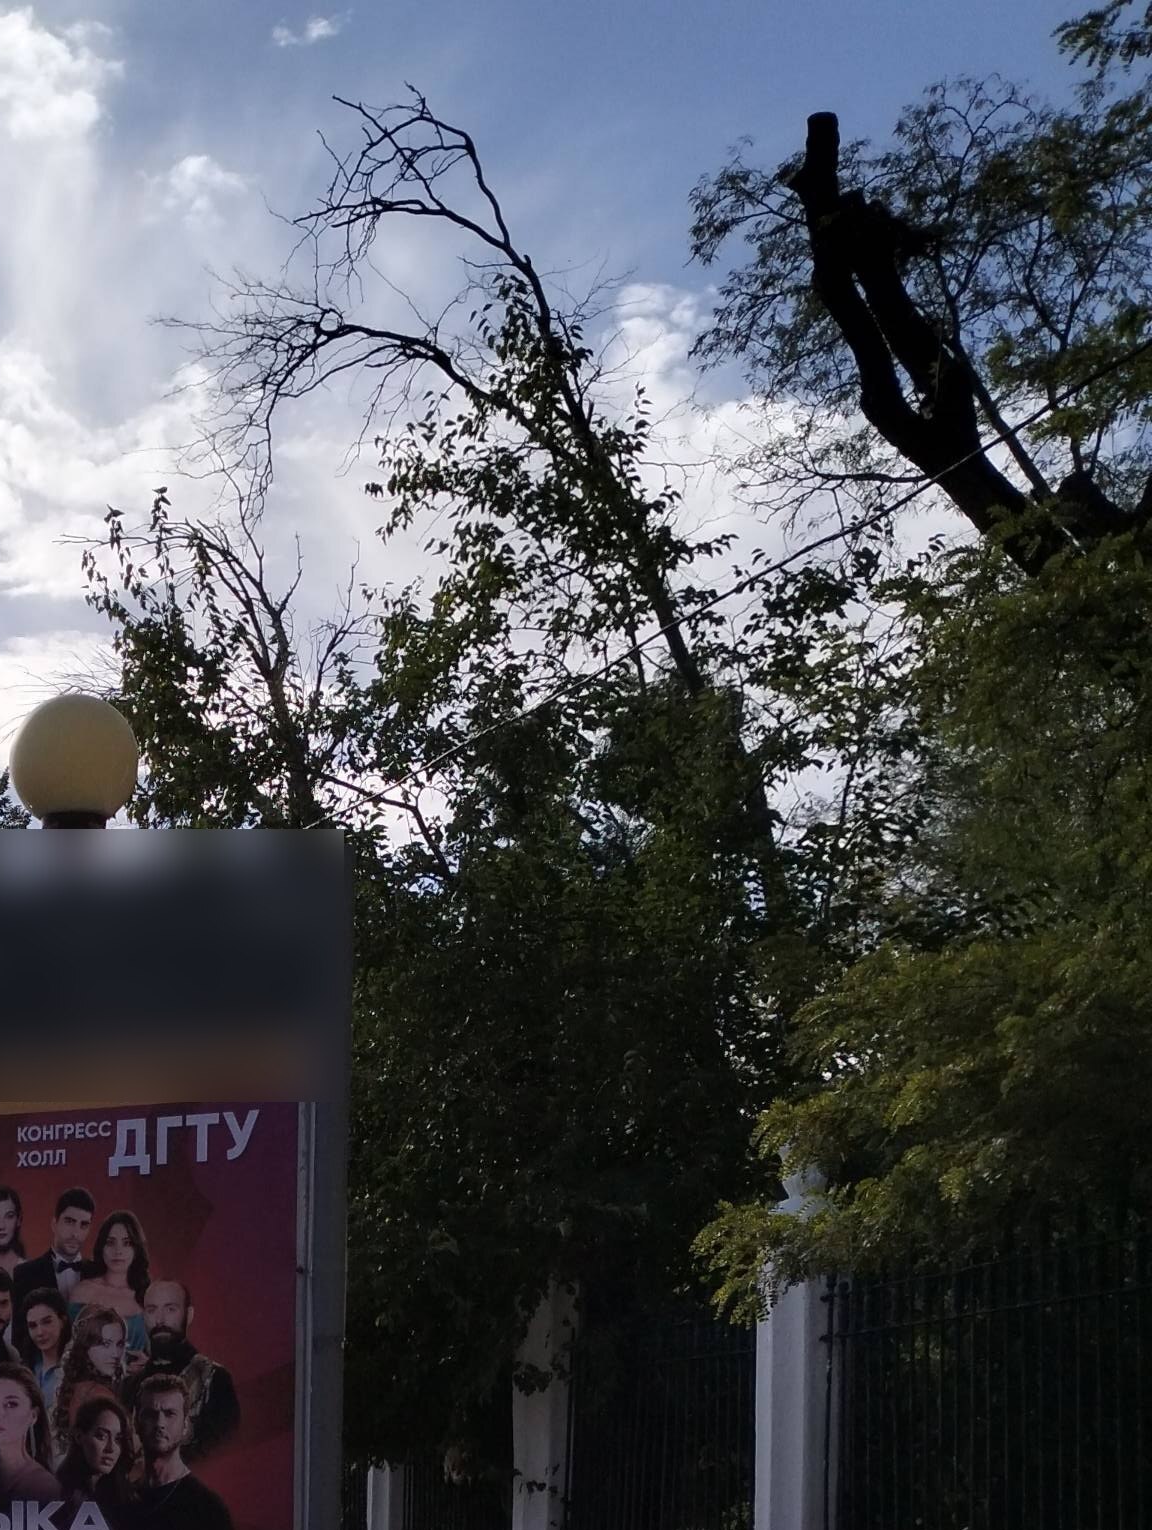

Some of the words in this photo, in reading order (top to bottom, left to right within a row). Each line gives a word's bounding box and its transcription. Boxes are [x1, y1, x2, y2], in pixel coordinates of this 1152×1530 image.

[17, 1121, 112, 1144] КОНГРЕСС
[109, 1110, 260, 1177] ДГТУ
[17, 1149, 67, 1168] ХОЛЛ
